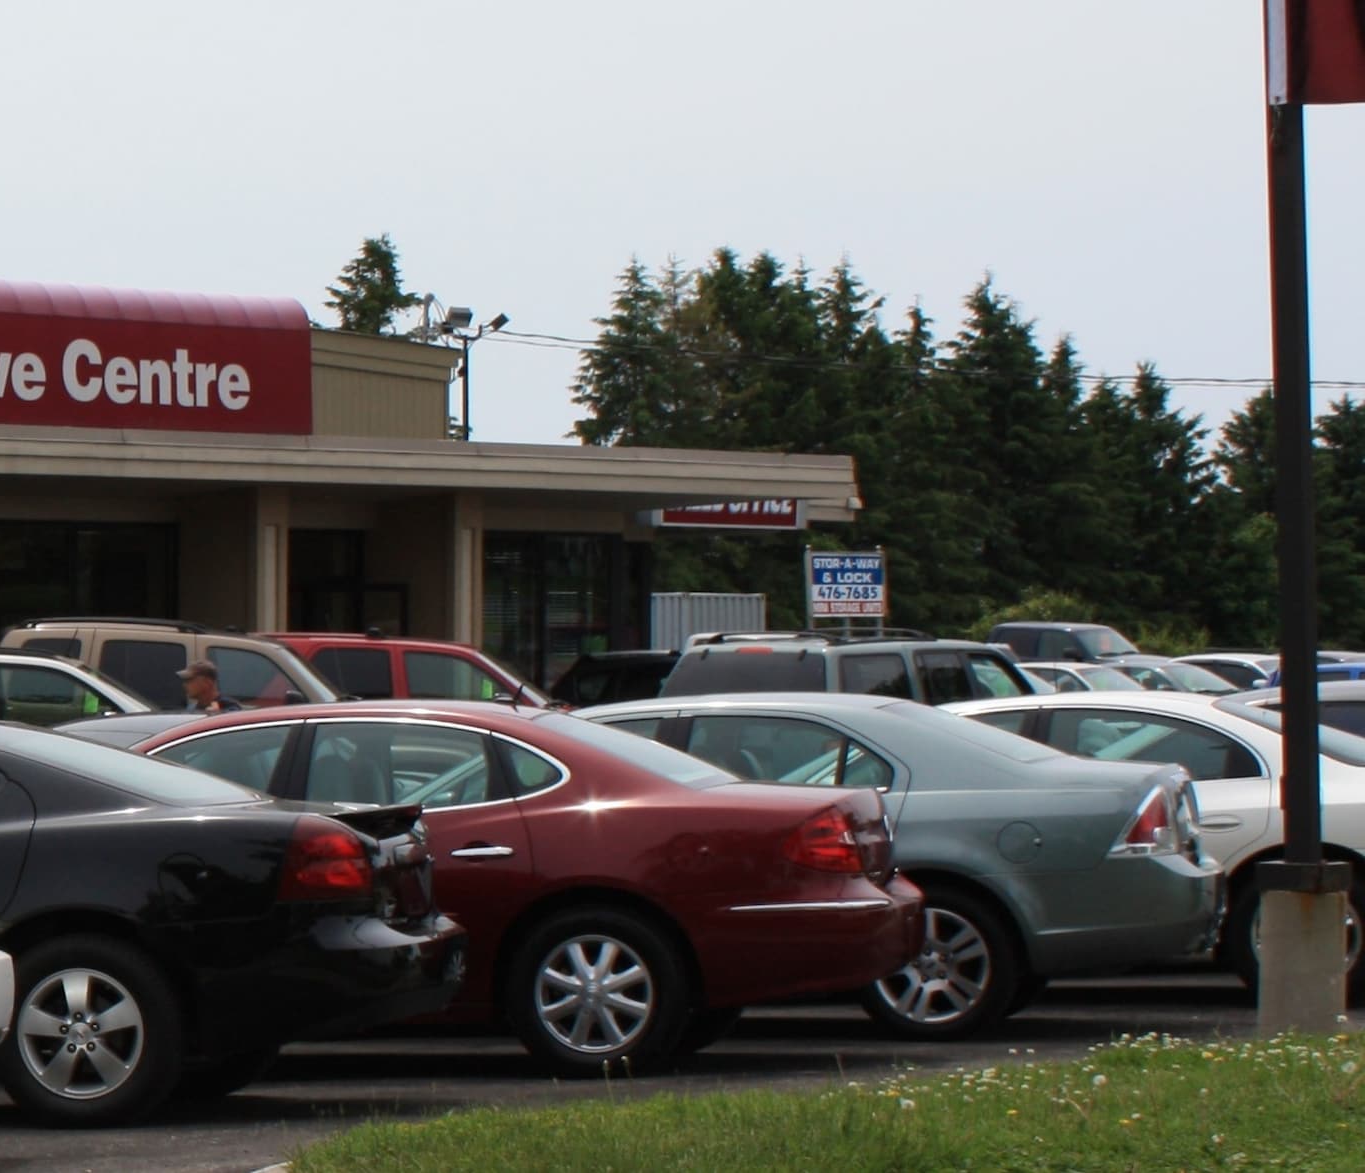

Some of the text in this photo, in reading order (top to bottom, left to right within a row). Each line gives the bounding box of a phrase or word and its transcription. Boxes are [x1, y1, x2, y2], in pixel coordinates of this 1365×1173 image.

[61, 338, 252, 412] Centre
[813, 558, 880, 569] STOR-A-WAY
[836, 572, 873, 584] LOCK
[816, 586, 879, 600] 476-7685
